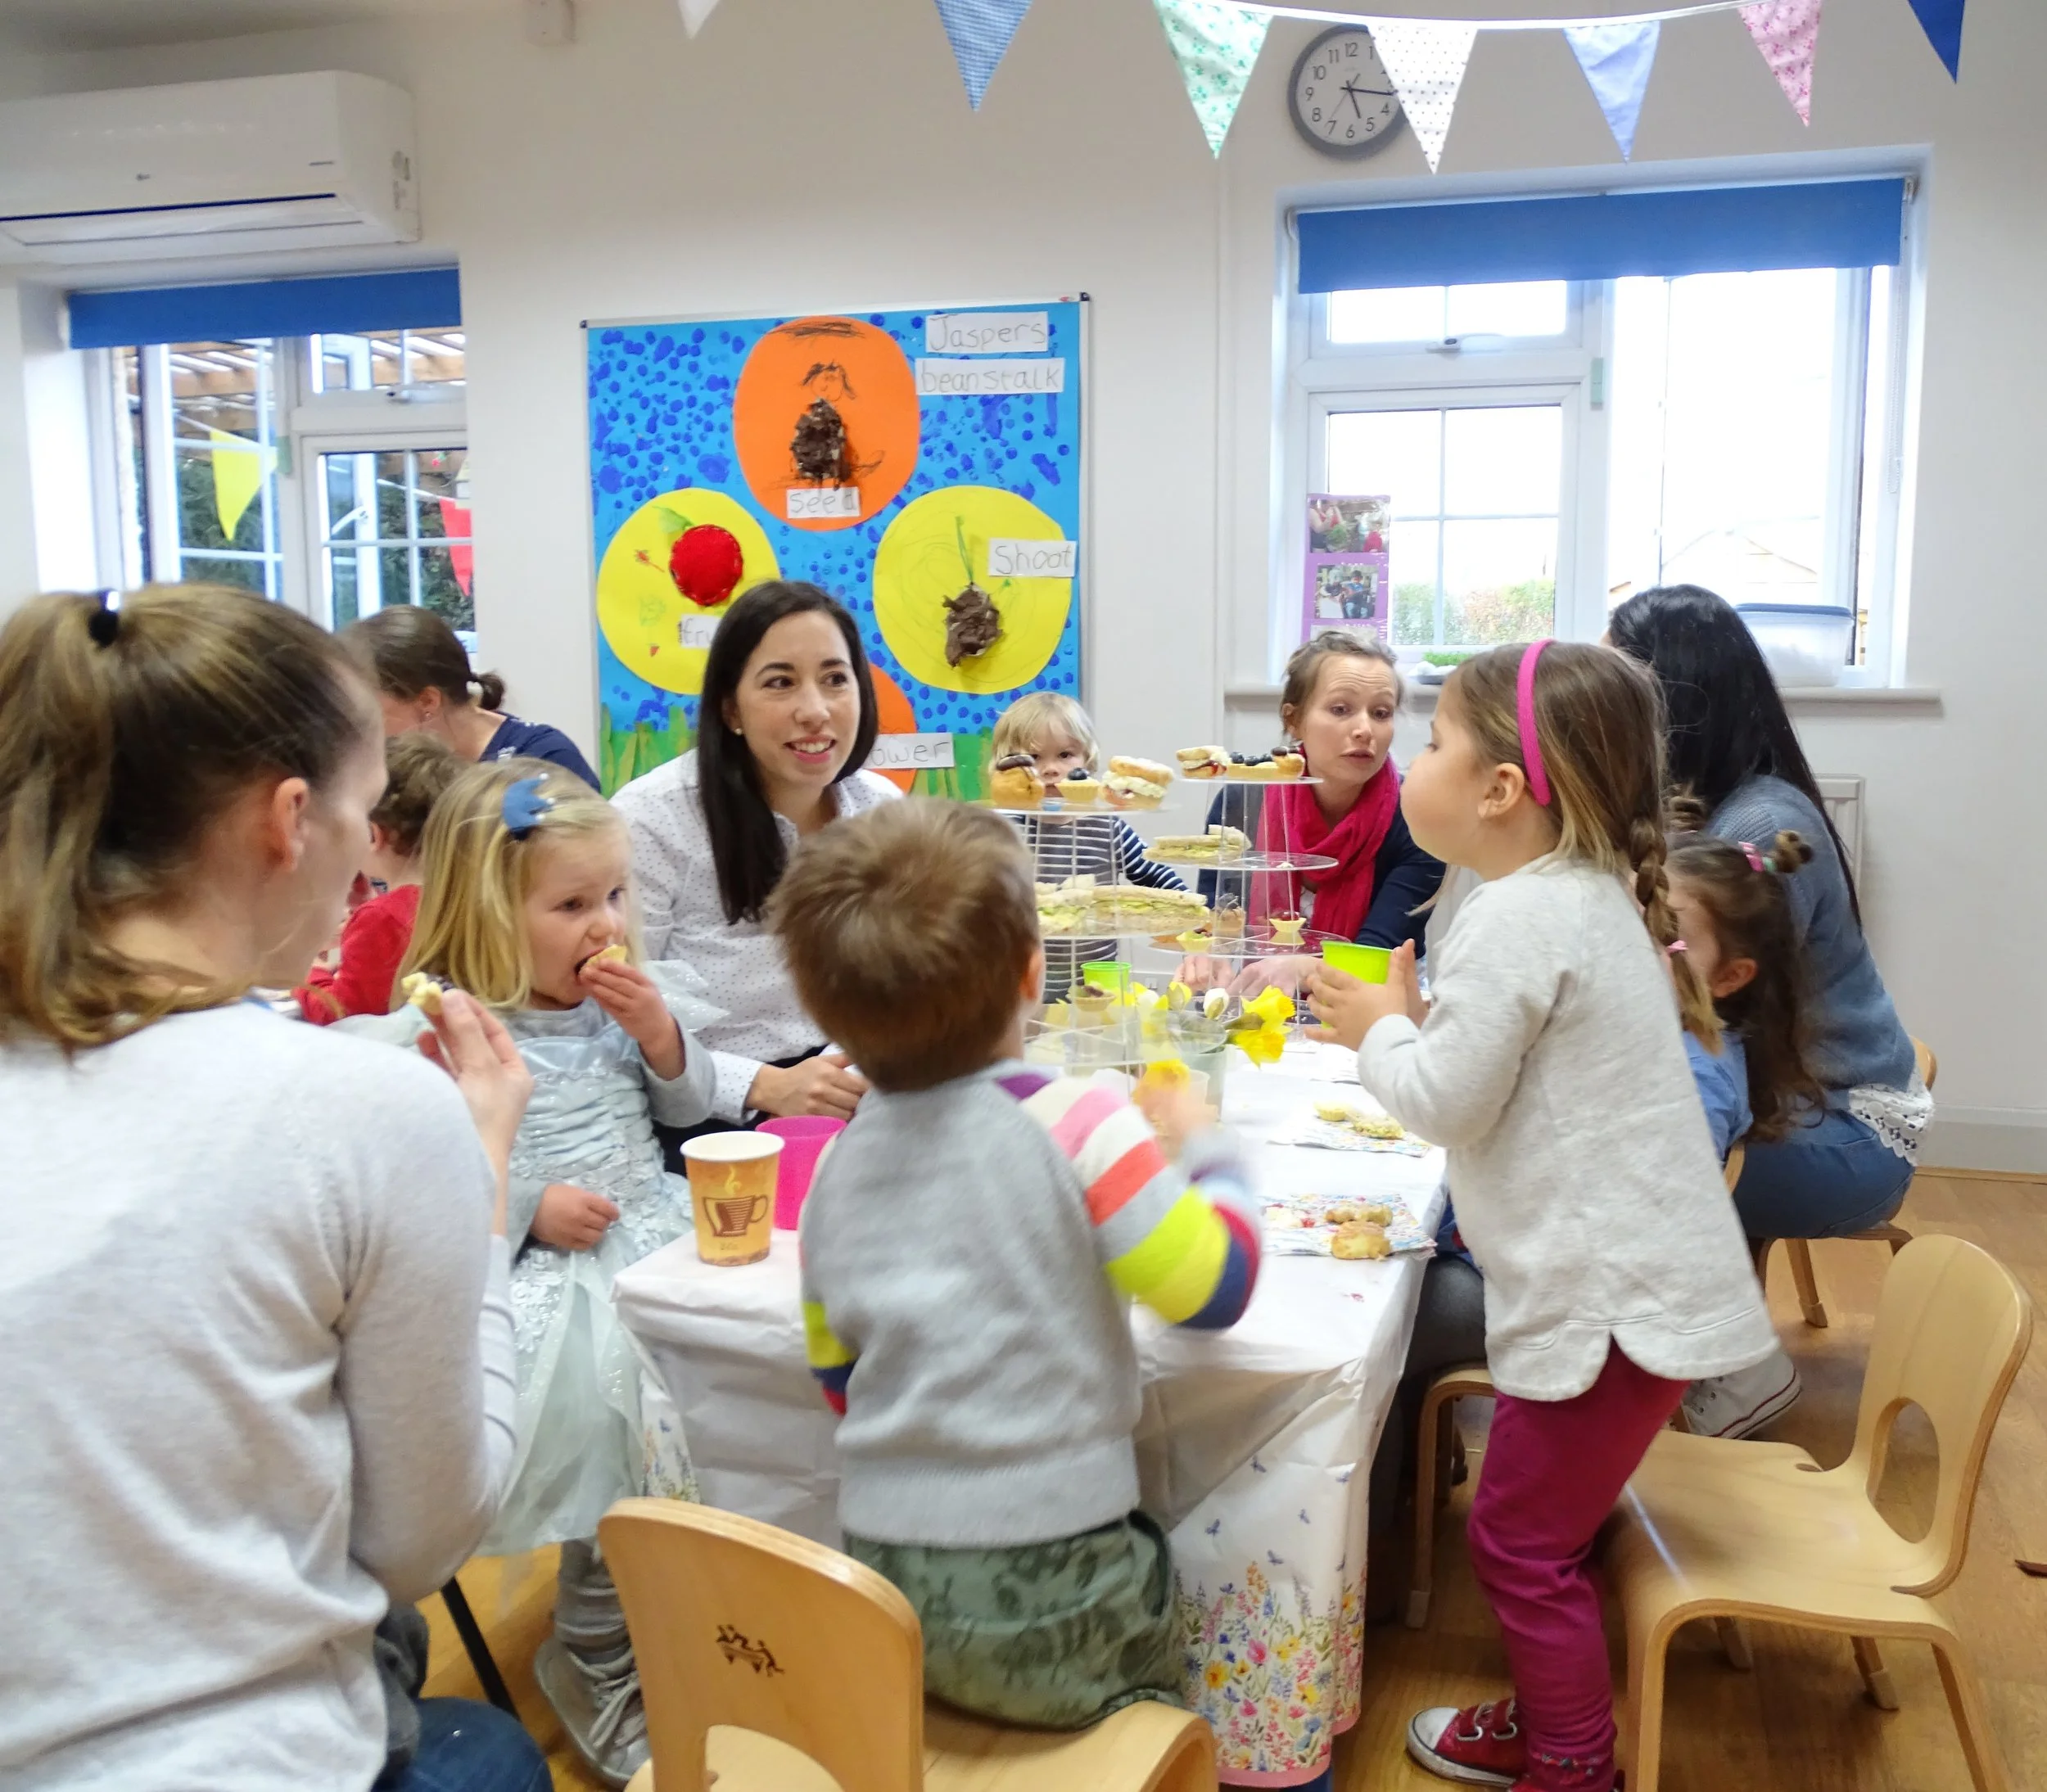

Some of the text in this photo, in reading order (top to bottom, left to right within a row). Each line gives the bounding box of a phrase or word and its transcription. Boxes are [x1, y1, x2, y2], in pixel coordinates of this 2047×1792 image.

[1328, 49, 1340, 64] 11
[1344, 42, 1358, 57] 12
[1368, 46, 1374, 60] 1
[1313, 65, 1326, 80] 10
[1305, 87, 1314, 102] 9
[1312, 107, 1322, 122] 8
[1380, 102, 1390, 116] 4
[1327, 120, 1337, 135] 7
[1345, 124, 1355, 138] 6
[1365, 117, 1375, 132] 5
[929, 314, 1047, 351] Jaspers
[921, 359, 1061, 393] beanstalk
[870, 741, 951, 766] ower
